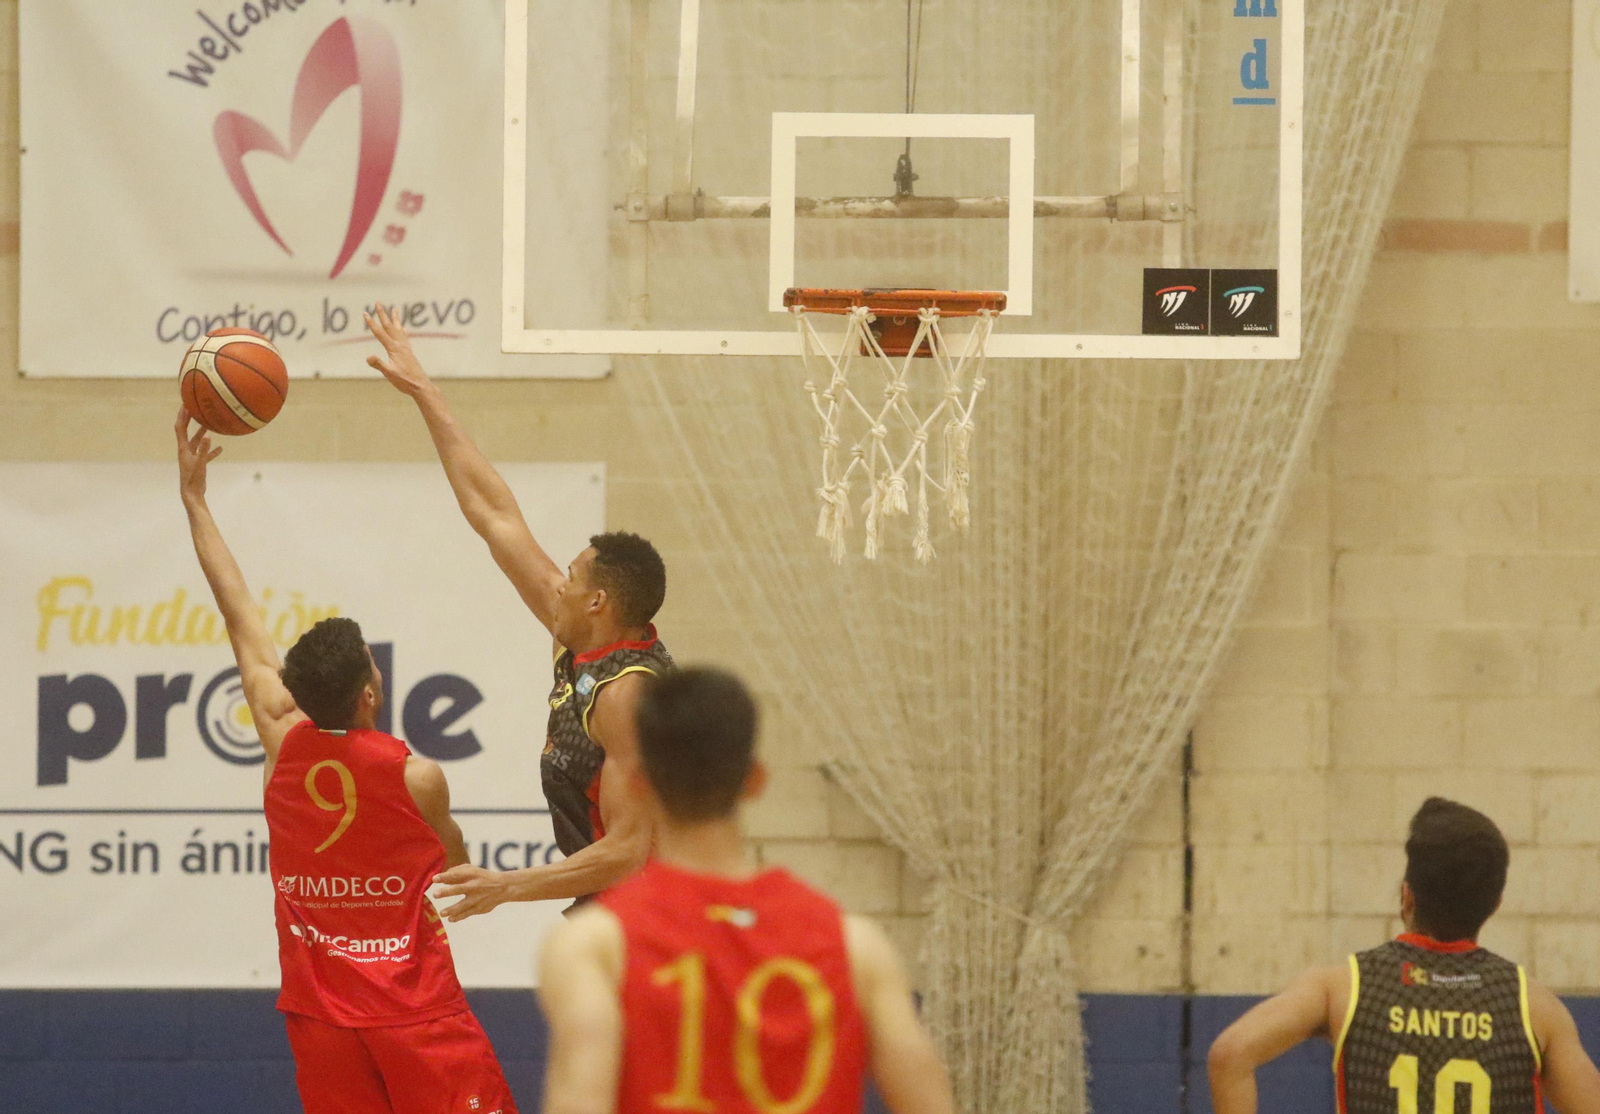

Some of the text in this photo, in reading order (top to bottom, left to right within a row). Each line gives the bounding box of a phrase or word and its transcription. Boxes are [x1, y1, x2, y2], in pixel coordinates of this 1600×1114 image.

[167, 0, 306, 88] Welcom
[322, 298, 349, 333] lo
[304, 759, 357, 854] 9
[90, 830, 160, 875] sin
[181, 828, 270, 875] áni
[299, 875, 406, 897] IMDECO
[650, 953, 836, 1114] 10
[1388, 1005, 1494, 1042] SANTOS
[1387, 1053, 1492, 1114] 10
